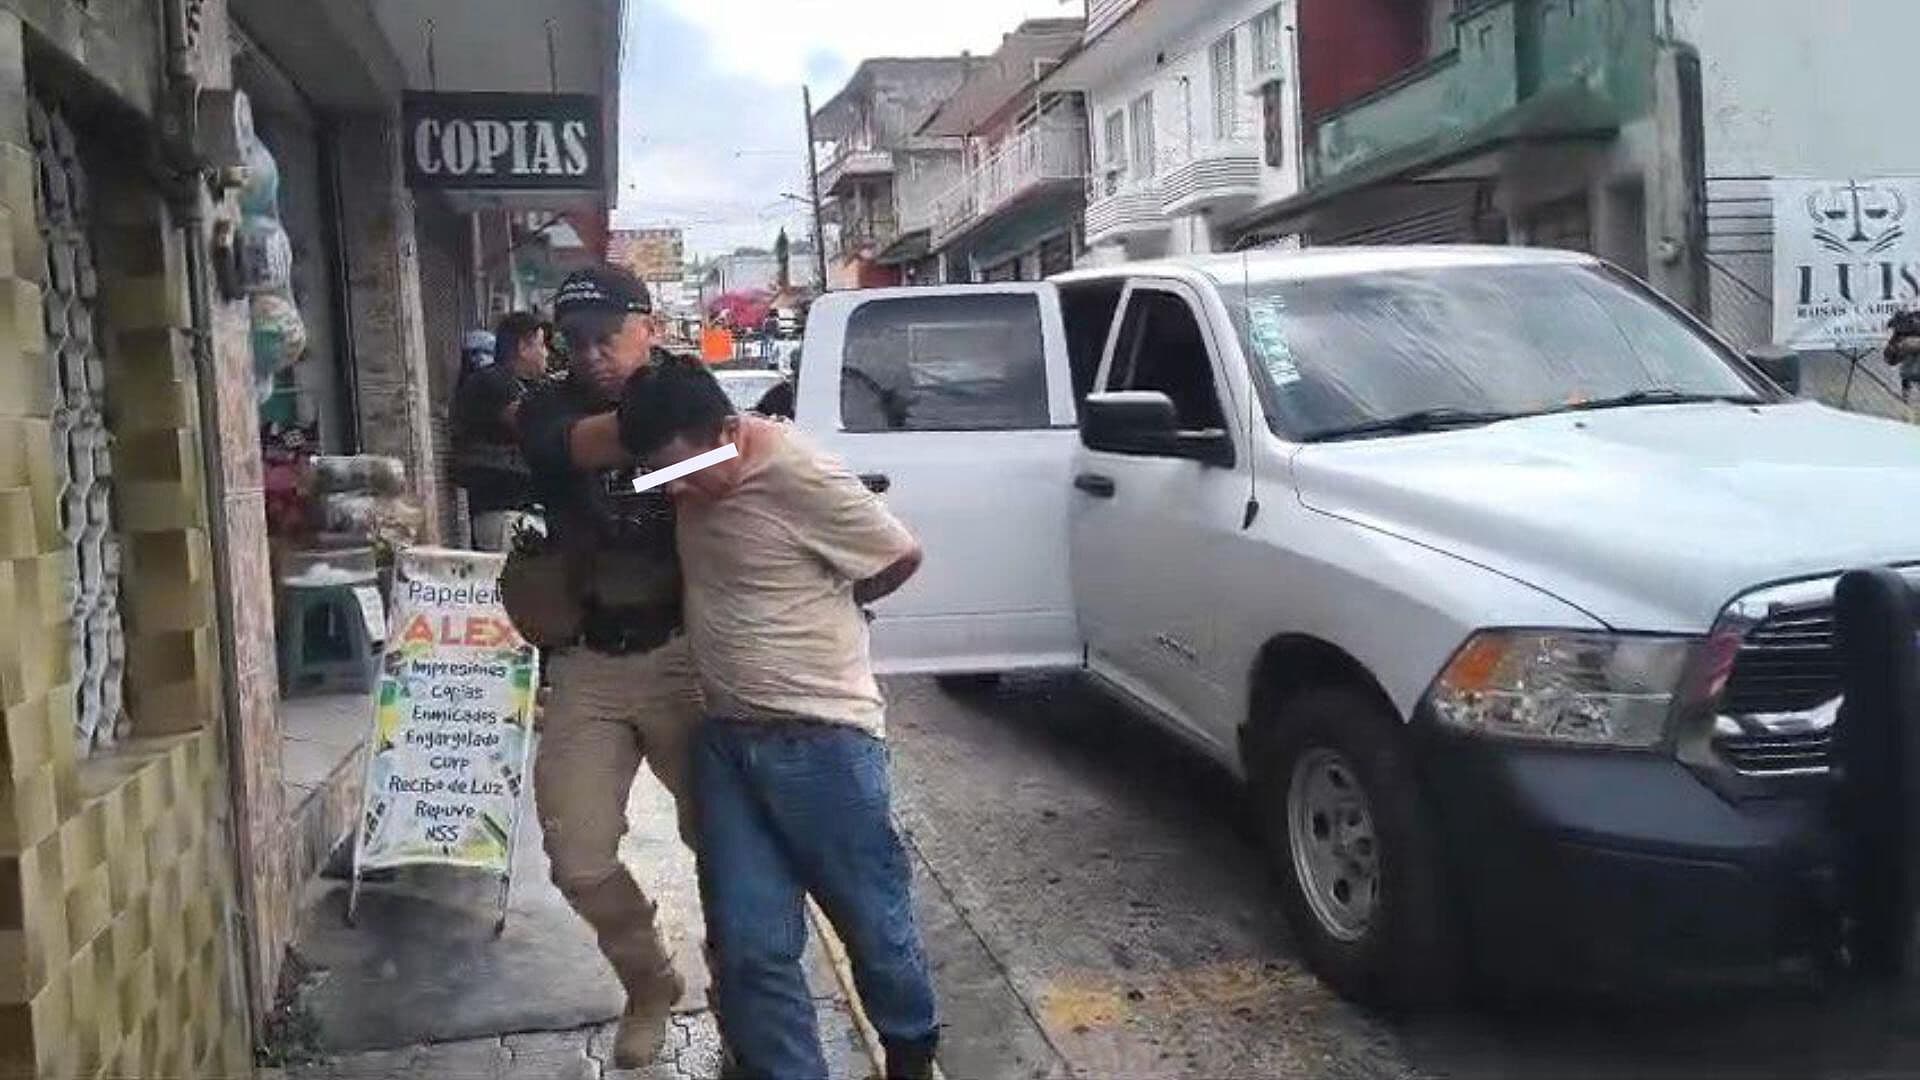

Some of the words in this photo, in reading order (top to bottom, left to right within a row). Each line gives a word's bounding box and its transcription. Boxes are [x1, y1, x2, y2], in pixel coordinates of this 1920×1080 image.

[414, 118, 588, 175] COPIAS
[1796, 262, 1920, 304] LUIS
[404, 614, 515, 646] ALEX
[389, 775, 443, 793] Recibo
[448, 778, 467, 792] de
[471, 776, 503, 795] Luz
[415, 800, 476, 820] Repuve
[425, 825, 458, 842] NSS
